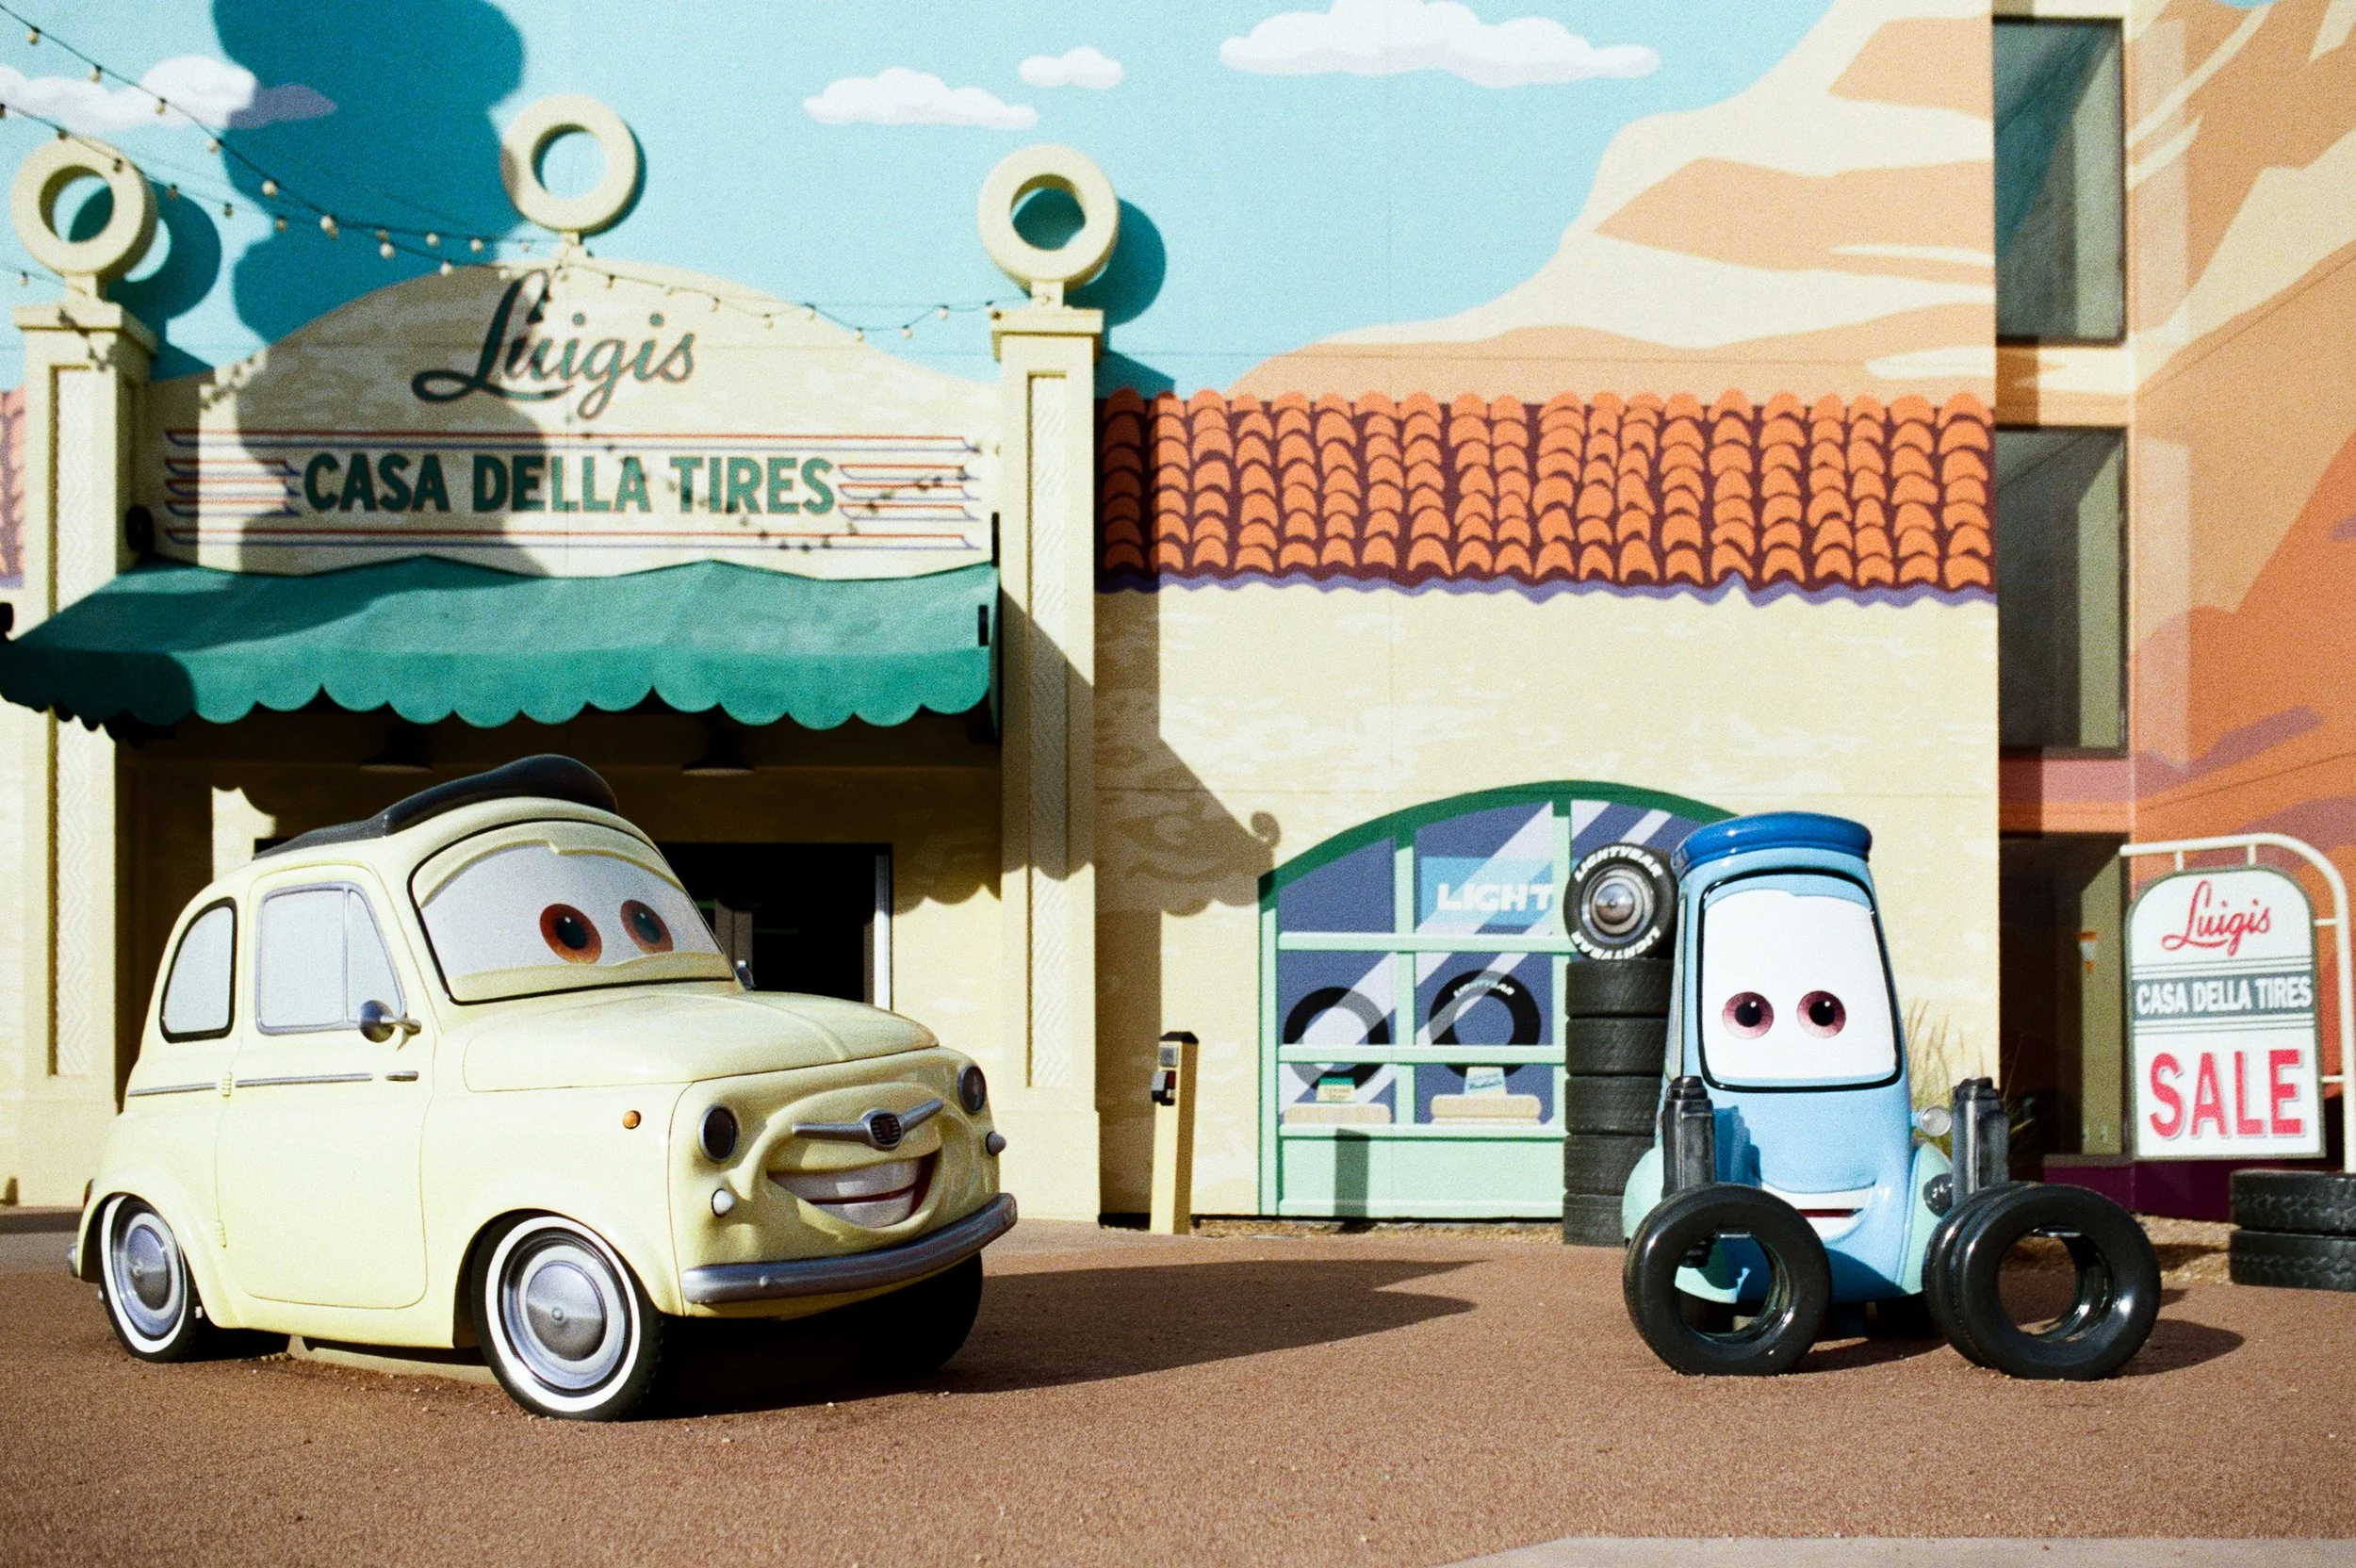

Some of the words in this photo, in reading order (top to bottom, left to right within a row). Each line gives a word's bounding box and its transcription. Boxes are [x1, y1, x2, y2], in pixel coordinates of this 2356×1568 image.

[411, 270, 695, 421] Luigis
[303, 453, 451, 513] CASA
[472, 455, 652, 514] DELLA
[669, 456, 836, 514] TIRES
[1574, 845, 1663, 882] LIGHTYEAR
[1437, 883, 1554, 910] LIGHT
[2161, 879, 2271, 957] Luigis
[1571, 925, 1661, 960] LIGHTYEAR
[2135, 981, 2189, 1015] CASA
[2192, 978, 2252, 1012] DELLA
[2254, 975, 2314, 1009] TIRES
[2150, 1049, 2305, 1138] SALE
